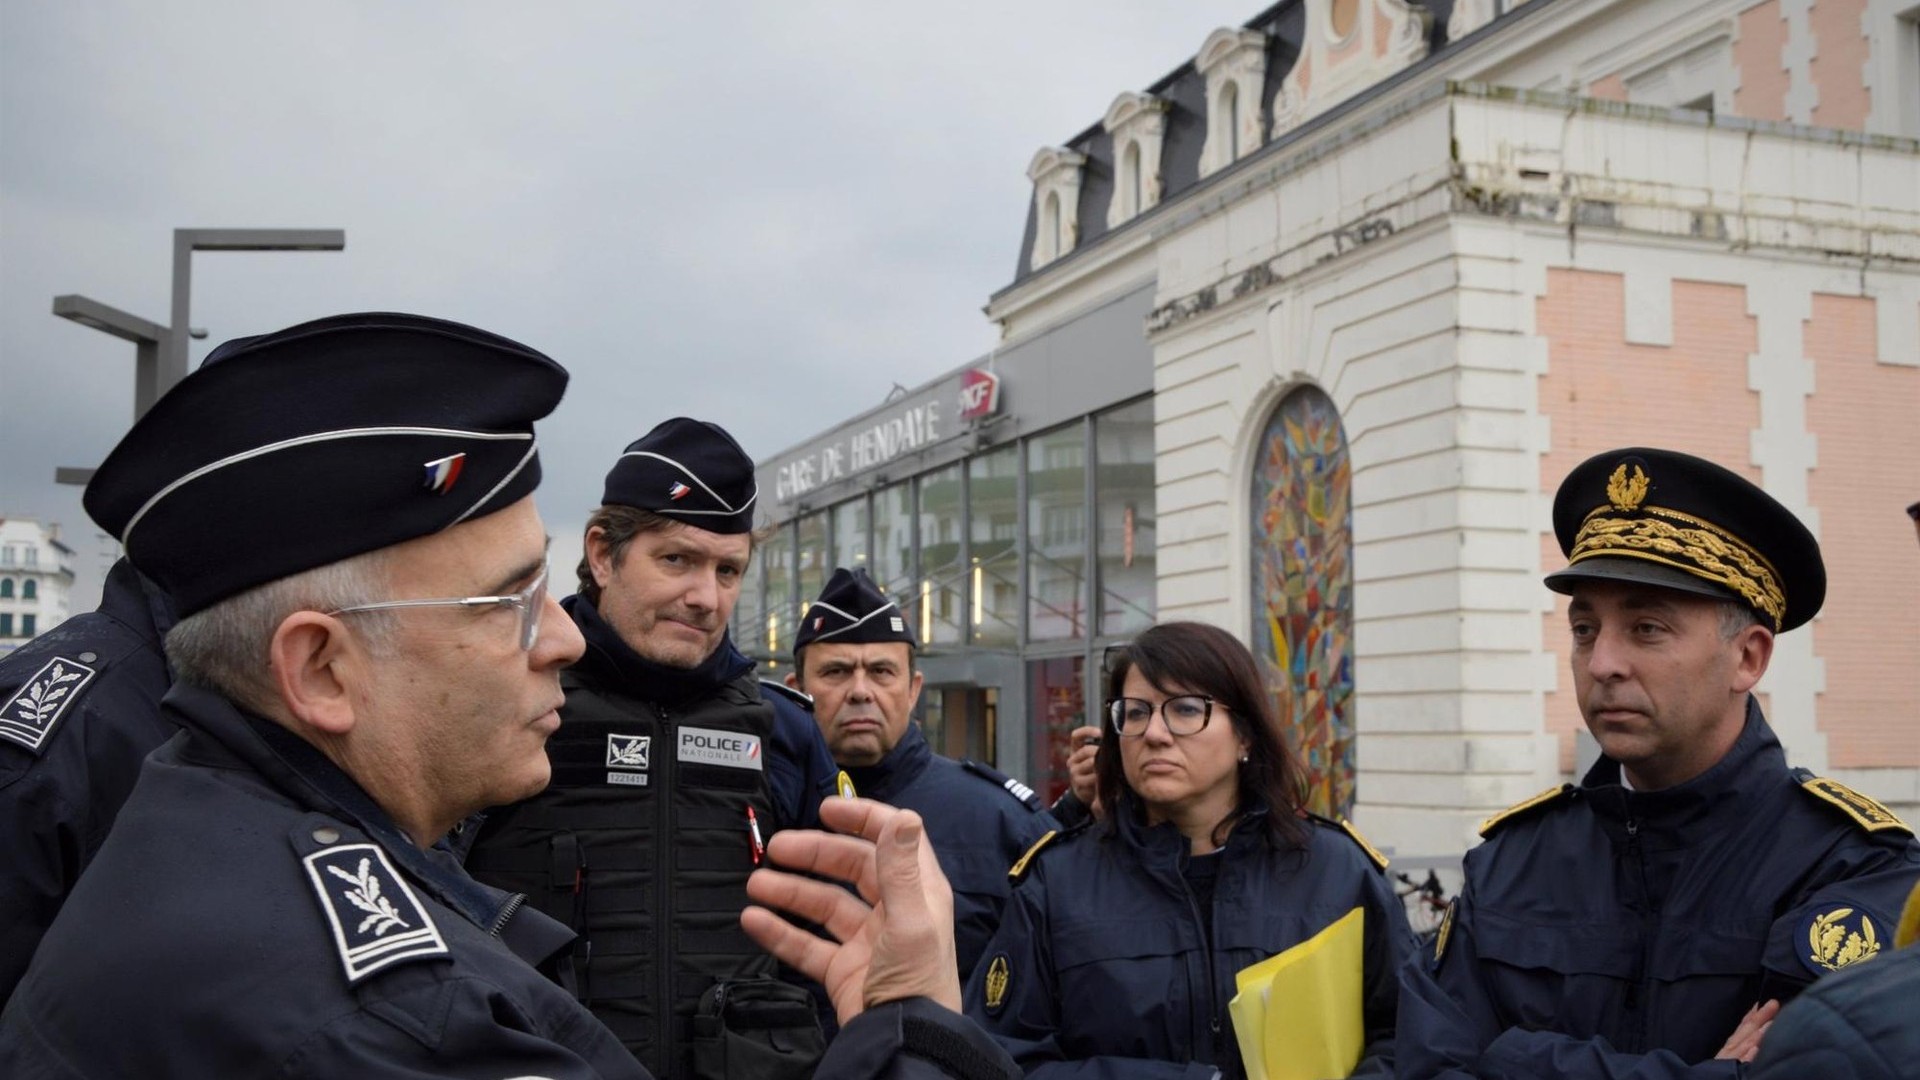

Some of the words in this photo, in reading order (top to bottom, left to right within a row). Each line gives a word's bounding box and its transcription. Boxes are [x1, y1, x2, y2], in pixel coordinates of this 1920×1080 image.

[776, 456, 815, 499] GARE
[822, 444, 843, 482] DE
[851, 401, 938, 471] HENDAYE
[682, 734, 742, 752] POLICE
[681, 748, 741, 762] NATIONALE
